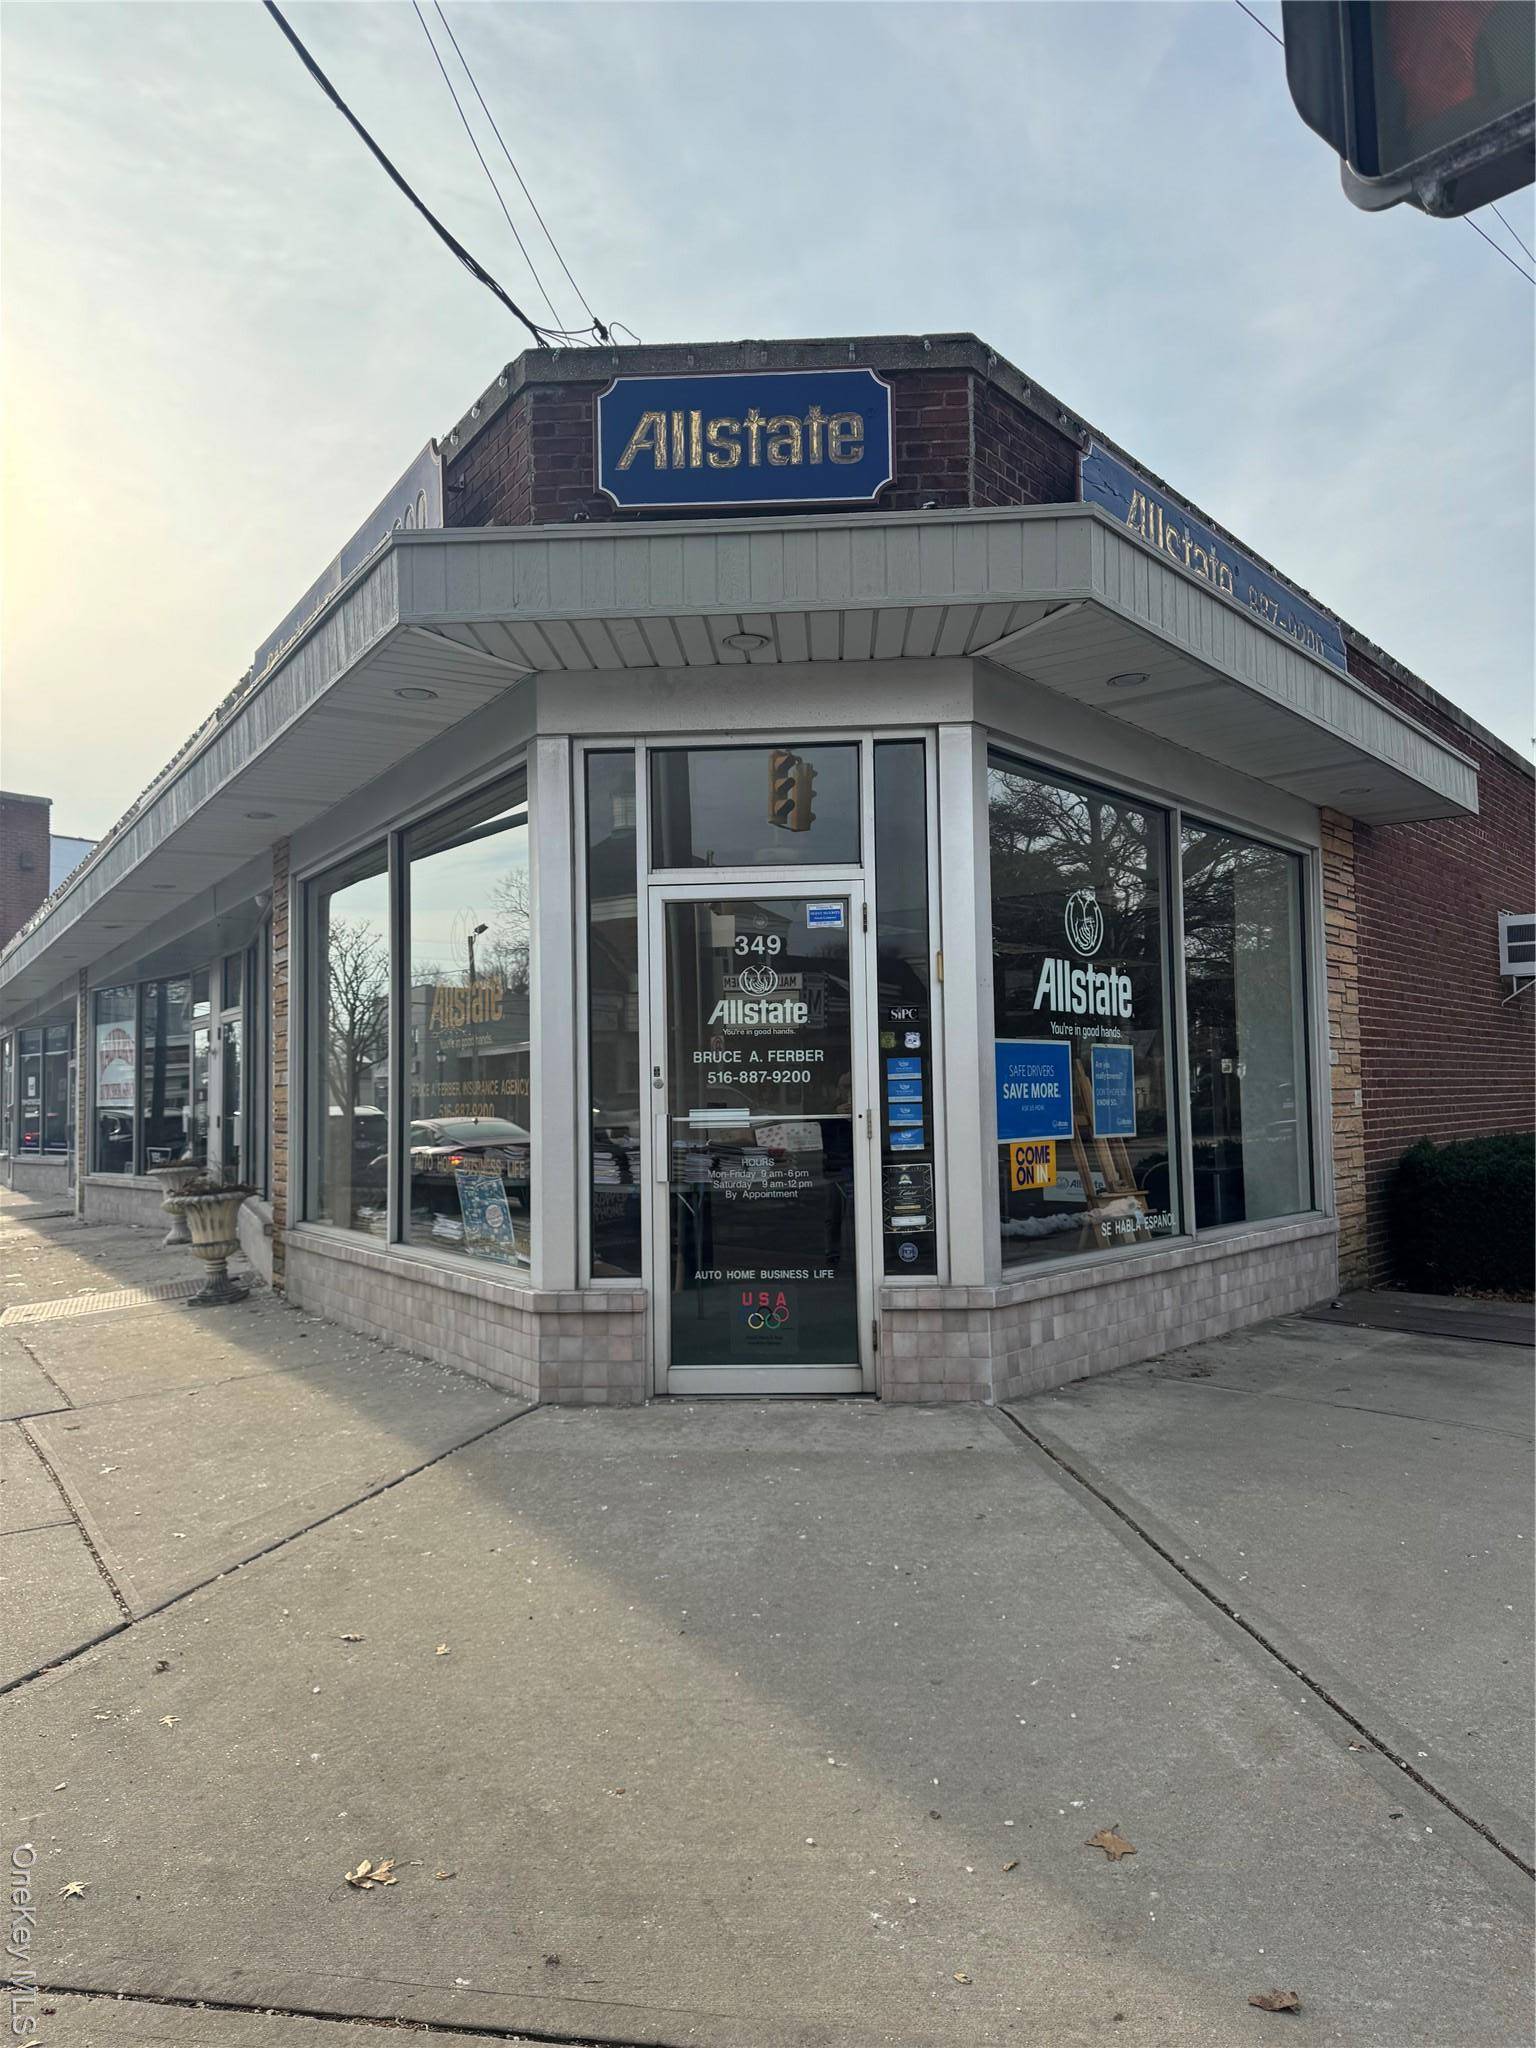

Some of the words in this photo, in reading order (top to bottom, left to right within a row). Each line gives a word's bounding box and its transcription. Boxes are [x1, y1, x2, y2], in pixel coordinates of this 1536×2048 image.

[614, 404, 866, 472] Allstate
[734, 934, 782, 956] 349
[1032, 957, 1134, 1019] Allstate
[707, 999, 808, 1026] Allstate
[722, 1027, 744, 1036] You're
[754, 1028, 772, 1037] good
[1050, 1021, 1073, 1035] You're
[1074, 1022, 1082, 1035] in
[1082, 1023, 1100, 1039] good
[693, 1050, 742, 1064] BRUCE
[749, 1050, 764, 1063] A.
[768, 1049, 825, 1063] FERBER
[707, 1070, 811, 1084] 516-887-9200
[1008, 1064, 1026, 1077] SAFE
[1027, 1064, 1055, 1077] DRIVERS
[463, 1079, 498, 1097] INSURANCE
[501, 1078, 530, 1096] AGENCY
[1003, 1082, 1029, 1099] SAVE
[1031, 1082, 1062, 1099] MORE.
[741, 1157, 776, 1167] HOURS
[1015, 1145, 1050, 1166] COME
[507, 1159, 526, 1178] LIFE
[707, 1169, 757, 1180] Mon-Friday
[761, 1169, 767, 1178] 9
[1016, 1165, 1034, 1186] ON
[1036, 1164, 1051, 1184] IN.
[712, 1180, 753, 1190] Saturday
[762, 1180, 768, 1189] 9
[725, 1190, 738, 1201] By
[742, 1189, 798, 1200] Appointment
[1101, 1221, 1112, 1237] SE
[1115, 1218, 1141, 1235] HABLA
[1144, 1209, 1177, 1231] ESPAÑOL
[694, 1270, 722, 1280] AUTO
[726, 1270, 756, 1279] HOME
[760, 1269, 809, 1279] BUSINESS
[813, 1269, 835, 1279] LIFE
[741, 1291, 788, 1306] USA
